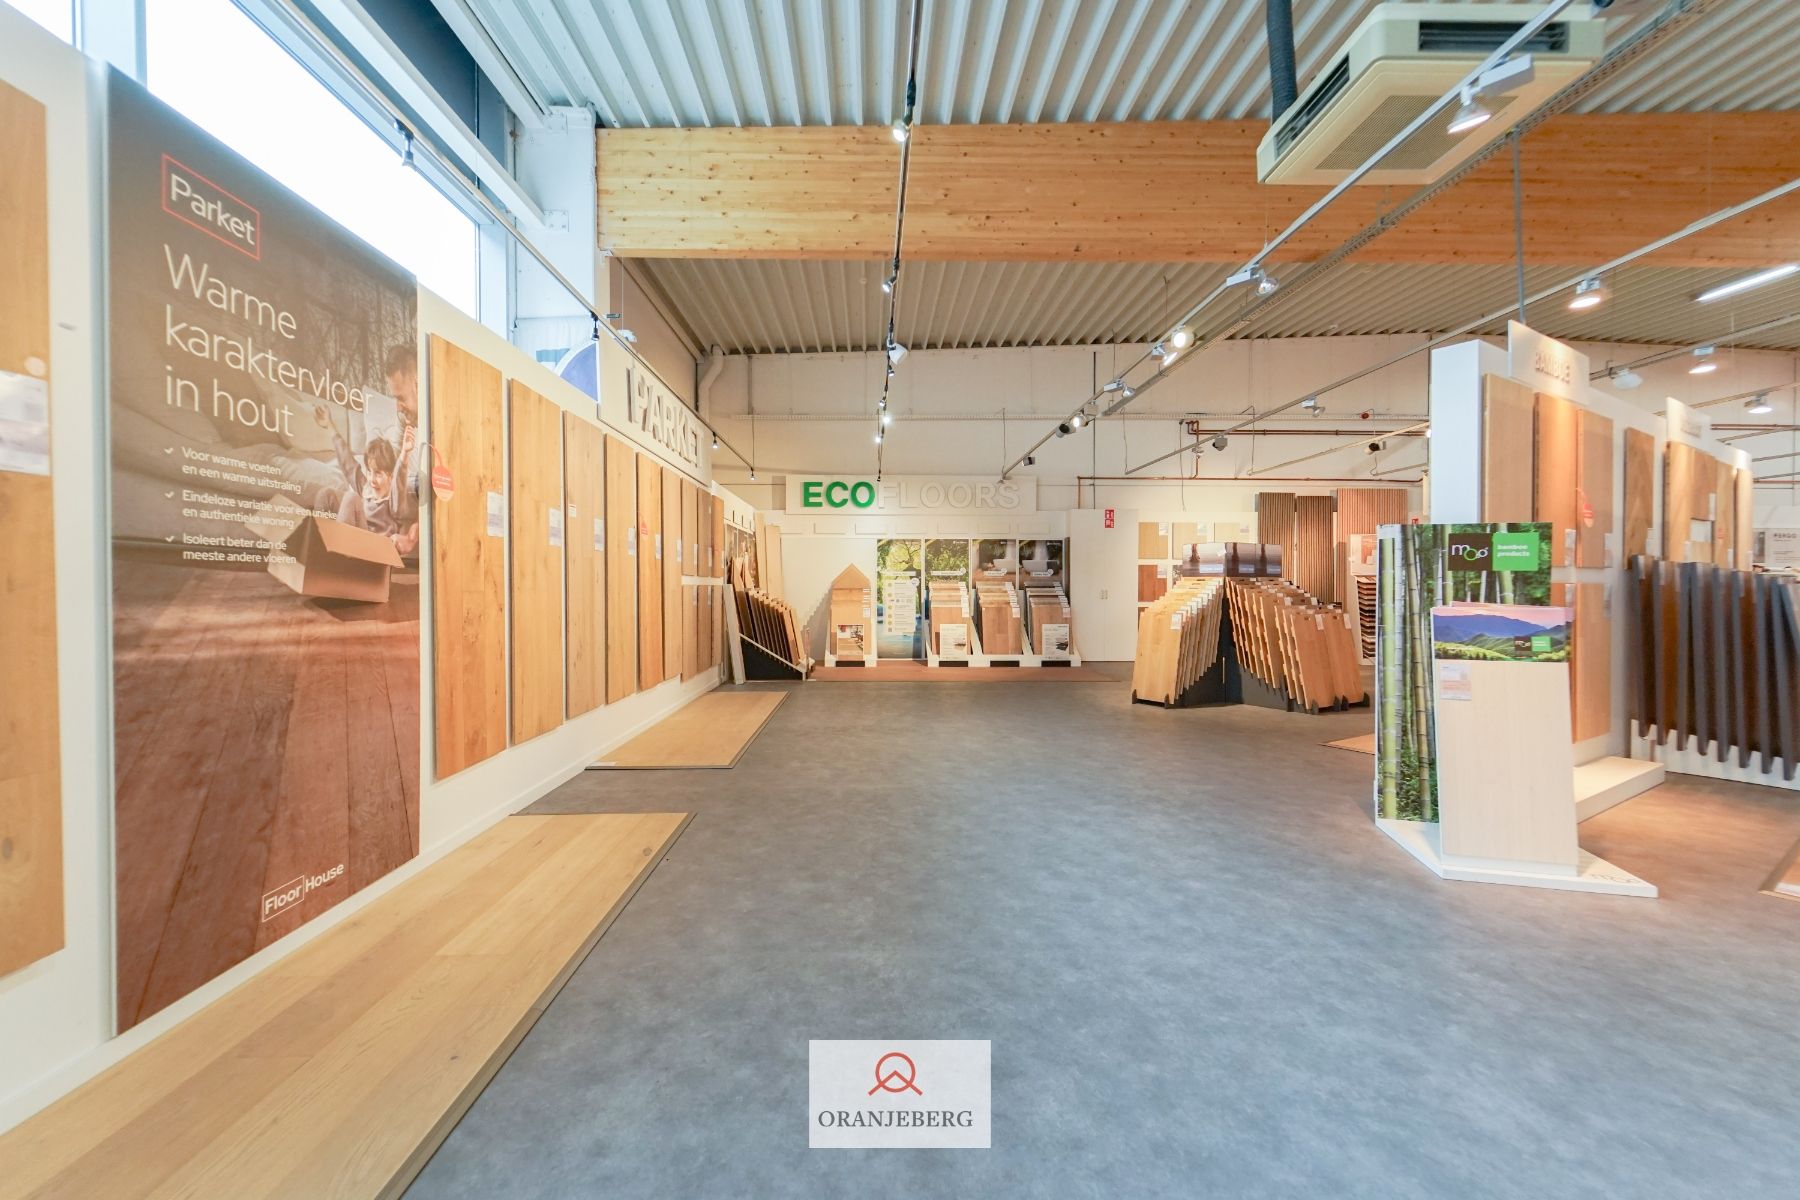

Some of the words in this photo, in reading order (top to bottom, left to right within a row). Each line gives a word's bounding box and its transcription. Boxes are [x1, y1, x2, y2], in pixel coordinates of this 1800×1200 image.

[171, 173, 255, 245] Parket
[164, 244, 296, 339] Warme
[166, 304, 373, 414] karaktervloer
[166, 365, 199, 412] in
[213, 378, 294, 437] hout
[626, 361, 705, 468] PARKET
[182, 446, 209, 461] Voor
[212, 454, 248, 469] warme
[248, 461, 281, 475] voeten
[182, 464, 197, 474] en
[200, 468, 220, 479] een
[222, 471, 256, 485] warme
[257, 477, 302, 494] uitstraling
[182, 489, 235, 507] Eindeloze
[237, 499, 272, 511] variatie
[274, 503, 295, 514] voor
[295, 507, 311, 517] een
[312, 508, 337, 520] unieke
[182, 507, 197, 517] en
[200, 510, 261, 525] authentieke
[262, 517, 294, 529] woning
[183, 532, 224, 546] Isoleert
[226, 537, 253, 548] beter
[256, 539, 273, 549] dan
[274, 540, 287, 550] de
[183, 550, 225, 561] meeste
[227, 553, 261, 563] andere
[263, 555, 296, 564] vloeren
[265, 885, 302, 915] Floor
[305, 864, 344, 892] House
